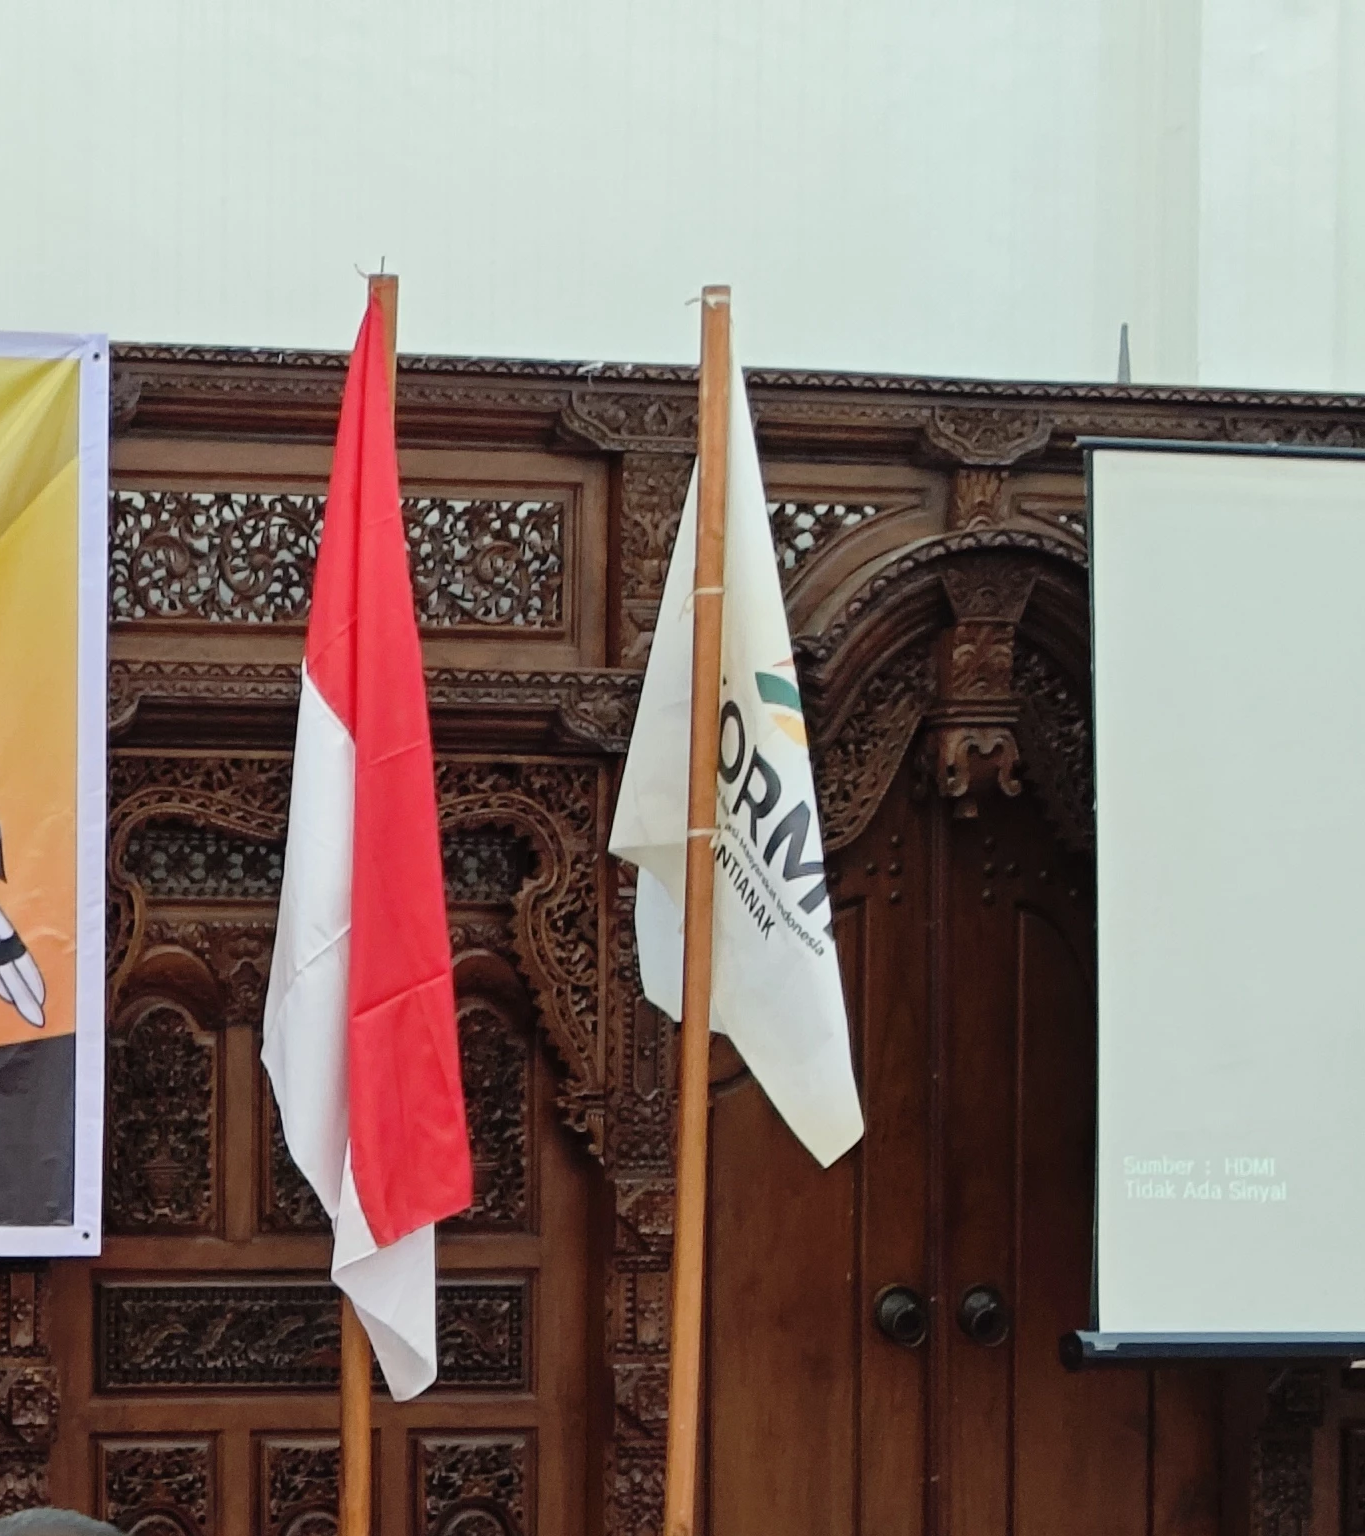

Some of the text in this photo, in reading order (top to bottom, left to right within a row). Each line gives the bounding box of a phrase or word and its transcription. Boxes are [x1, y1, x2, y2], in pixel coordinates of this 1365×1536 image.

[718, 700, 835, 942] ORM
[714, 844, 775, 941] NTIANAK
[776, 898, 825, 957] Indonesia
[1122, 1154, 1195, 1176] Sumber
[1224, 1157, 1275, 1177] HDMI
[1125, 1179, 1287, 1203] Tidak Ada Sinyal
